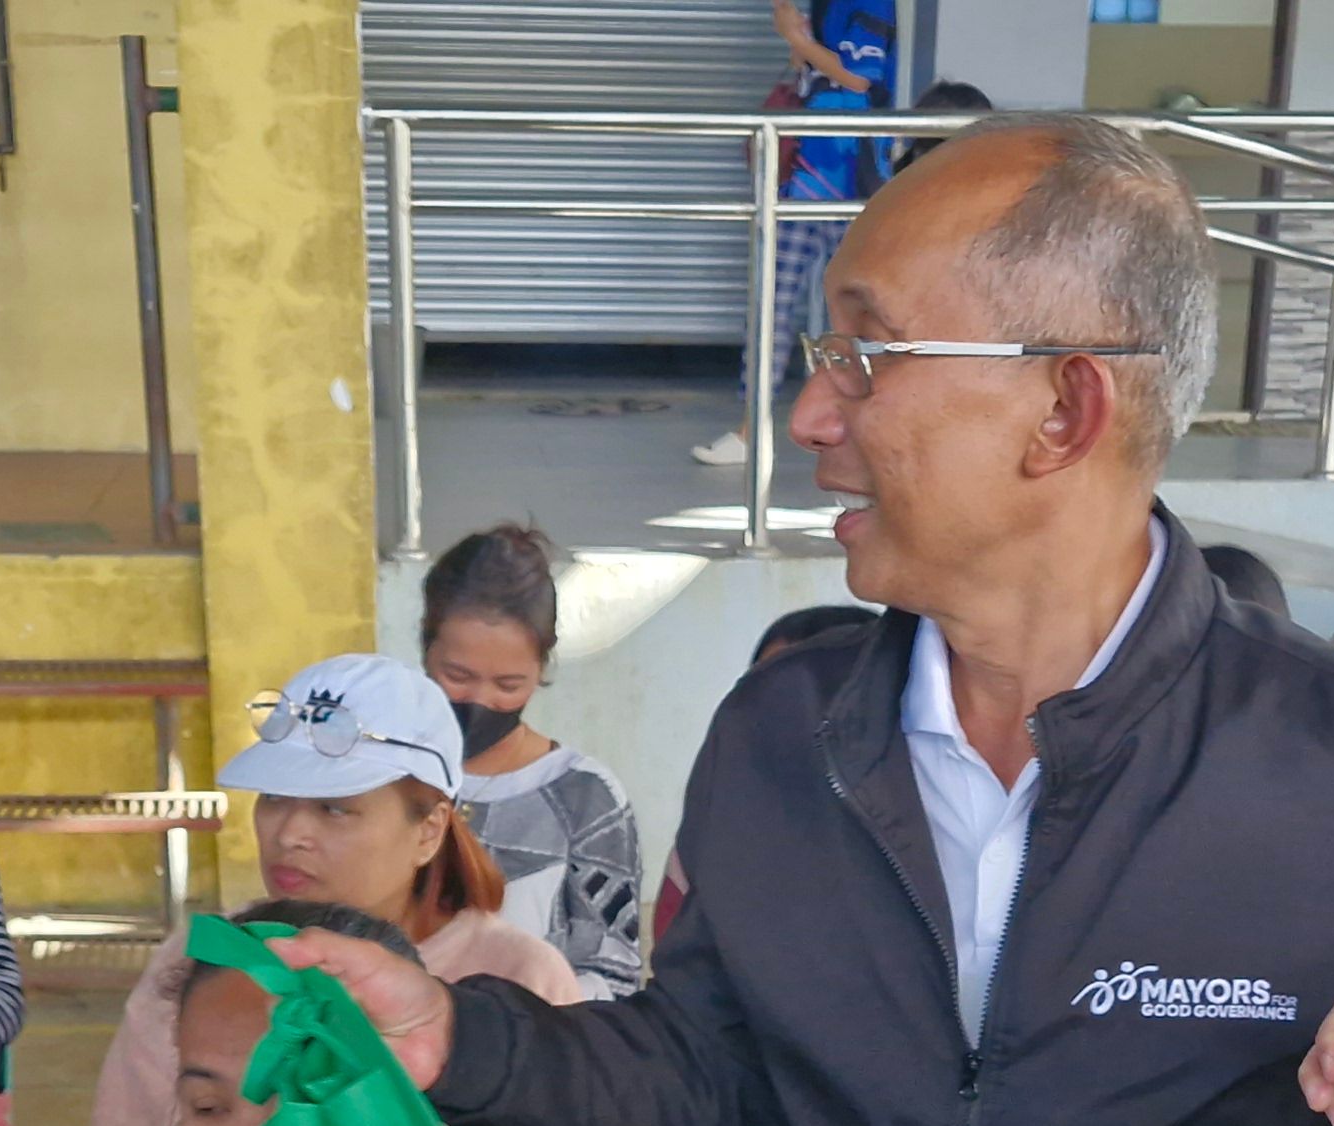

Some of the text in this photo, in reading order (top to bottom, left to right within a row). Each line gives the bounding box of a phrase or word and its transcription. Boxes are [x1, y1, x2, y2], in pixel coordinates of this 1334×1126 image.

[1140, 978, 1298, 1007] MAYORS FOR
[1141, 1003, 1297, 1020] GOOD GOVERNANCE
